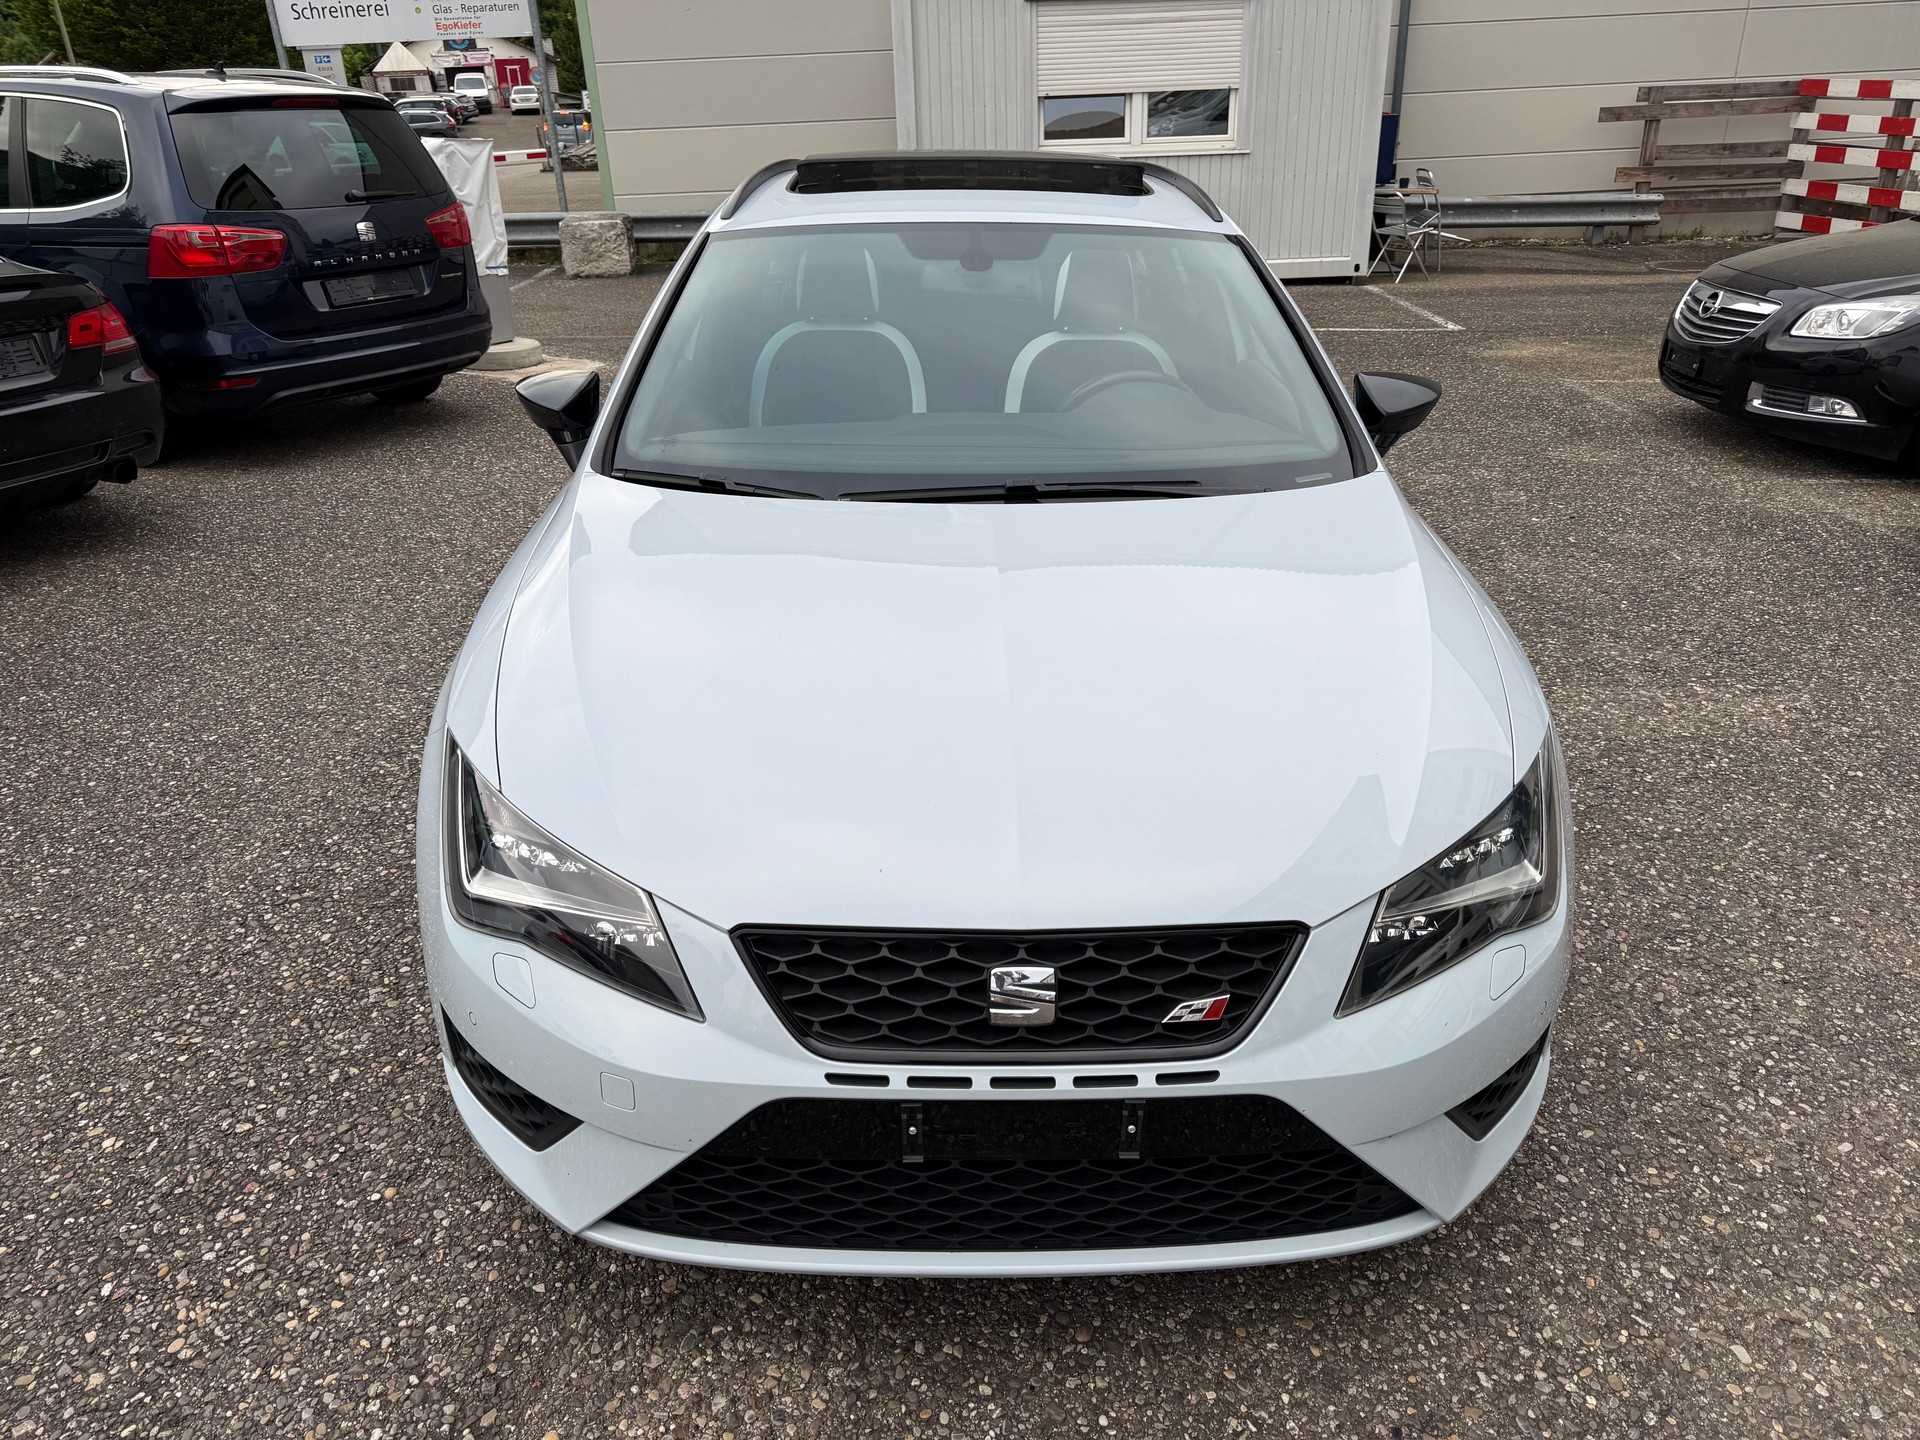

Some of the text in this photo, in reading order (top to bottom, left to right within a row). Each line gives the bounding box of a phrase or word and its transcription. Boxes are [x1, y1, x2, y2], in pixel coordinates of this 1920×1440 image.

[290, 0, 389, 20] Schreinerei
[432, 4, 453, 14] Glas
[460, 3, 520, 15] Reparaturen
[435, 21, 482, 32] EgoKiefer
[313, 248, 421, 267] ALHAMBRA
